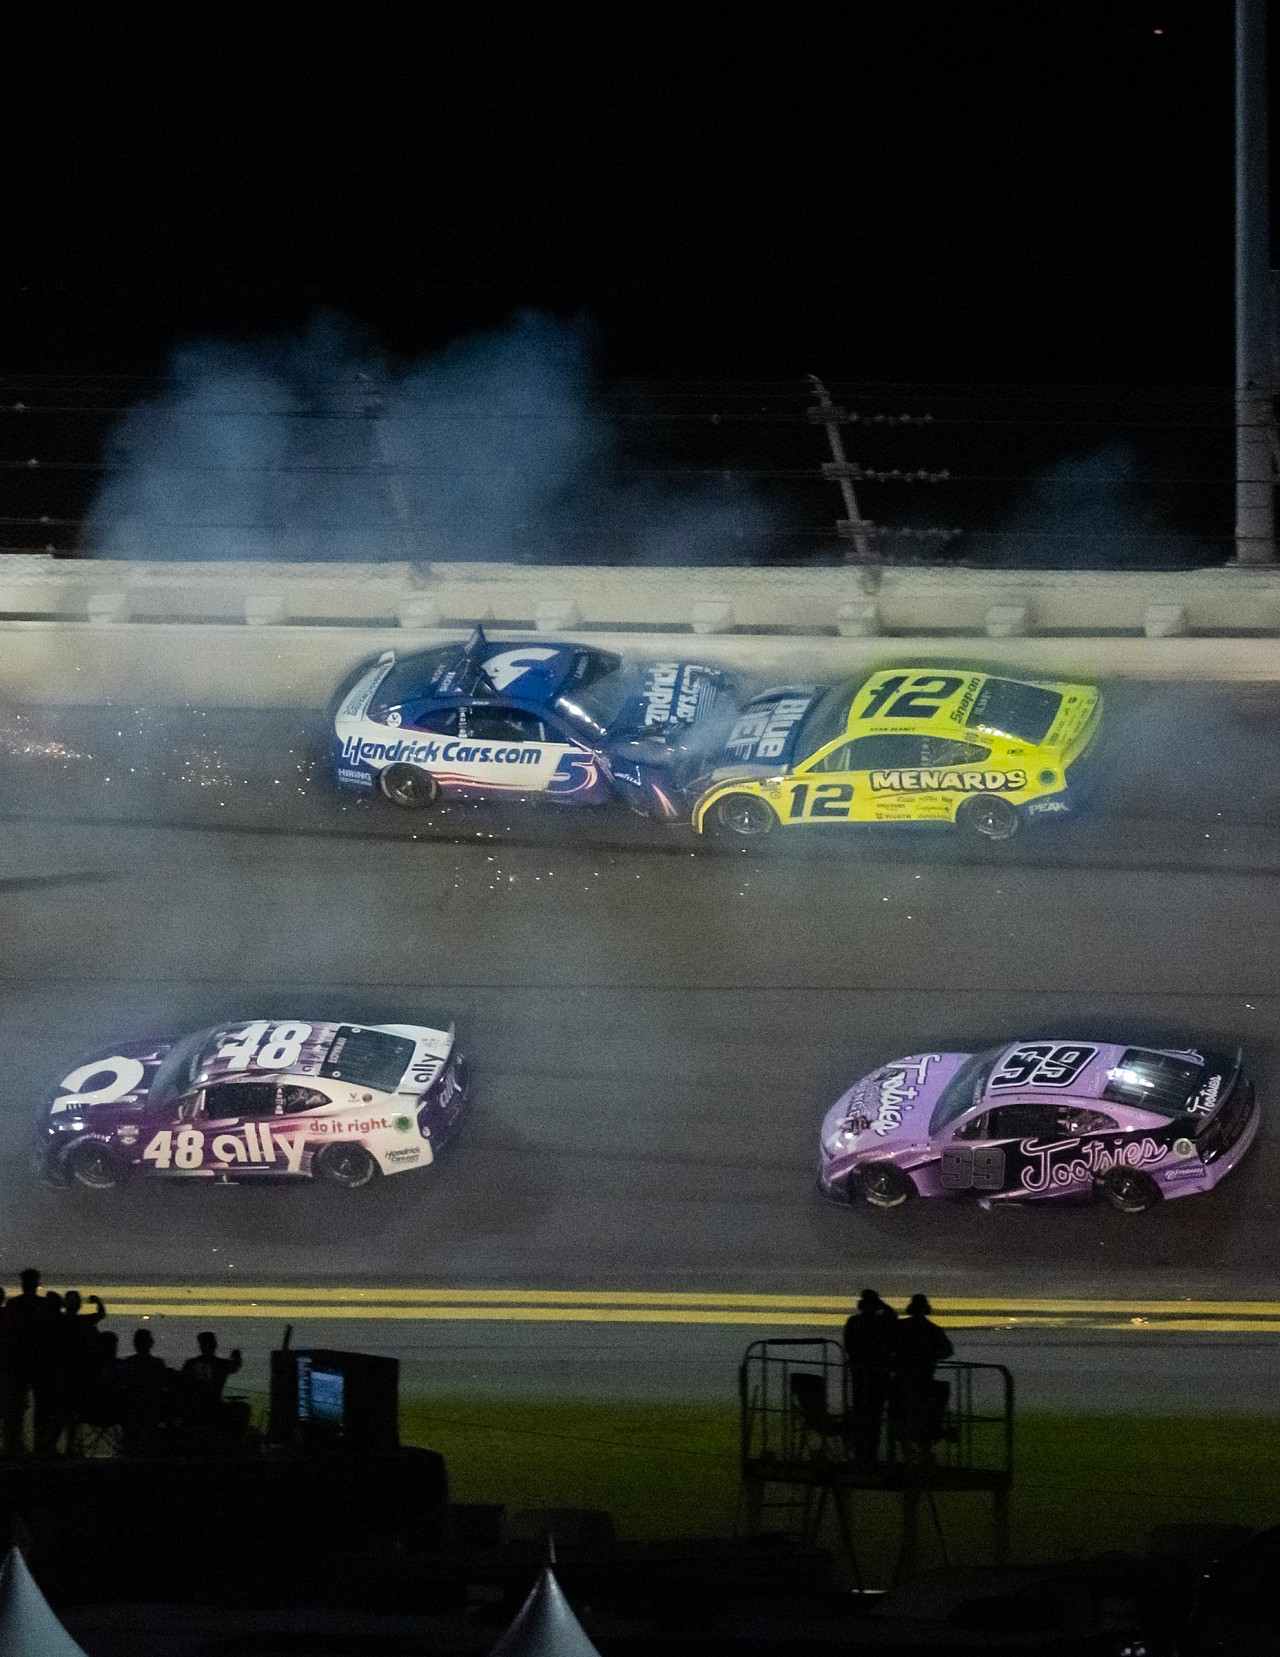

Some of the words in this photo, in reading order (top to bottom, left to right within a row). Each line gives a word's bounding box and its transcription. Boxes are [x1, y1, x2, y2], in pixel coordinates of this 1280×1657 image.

[859, 675, 965, 720] 12
[949, 676, 982, 727] Snap-on
[756, 698, 813, 758] Blue
[337, 768, 372, 782] HIRING
[544, 752, 598, 794] 5
[869, 769, 1028, 793] MENARDS
[789, 783, 855, 819] 12
[1028, 801, 1071, 815] PEAK
[217, 1023, 313, 1070] 48
[411, 1052, 446, 1084] ally
[990, 1044, 1099, 1088] 99
[309, 1119, 329, 1133] do
[331, 1118, 345, 1133] it
[347, 1117, 393, 1135] right.
[142, 1129, 205, 1169] 48
[212, 1122, 307, 1174] ally
[939, 1145, 1006, 1190] 99
[1021, 1136, 1169, 1193] Tootsies
